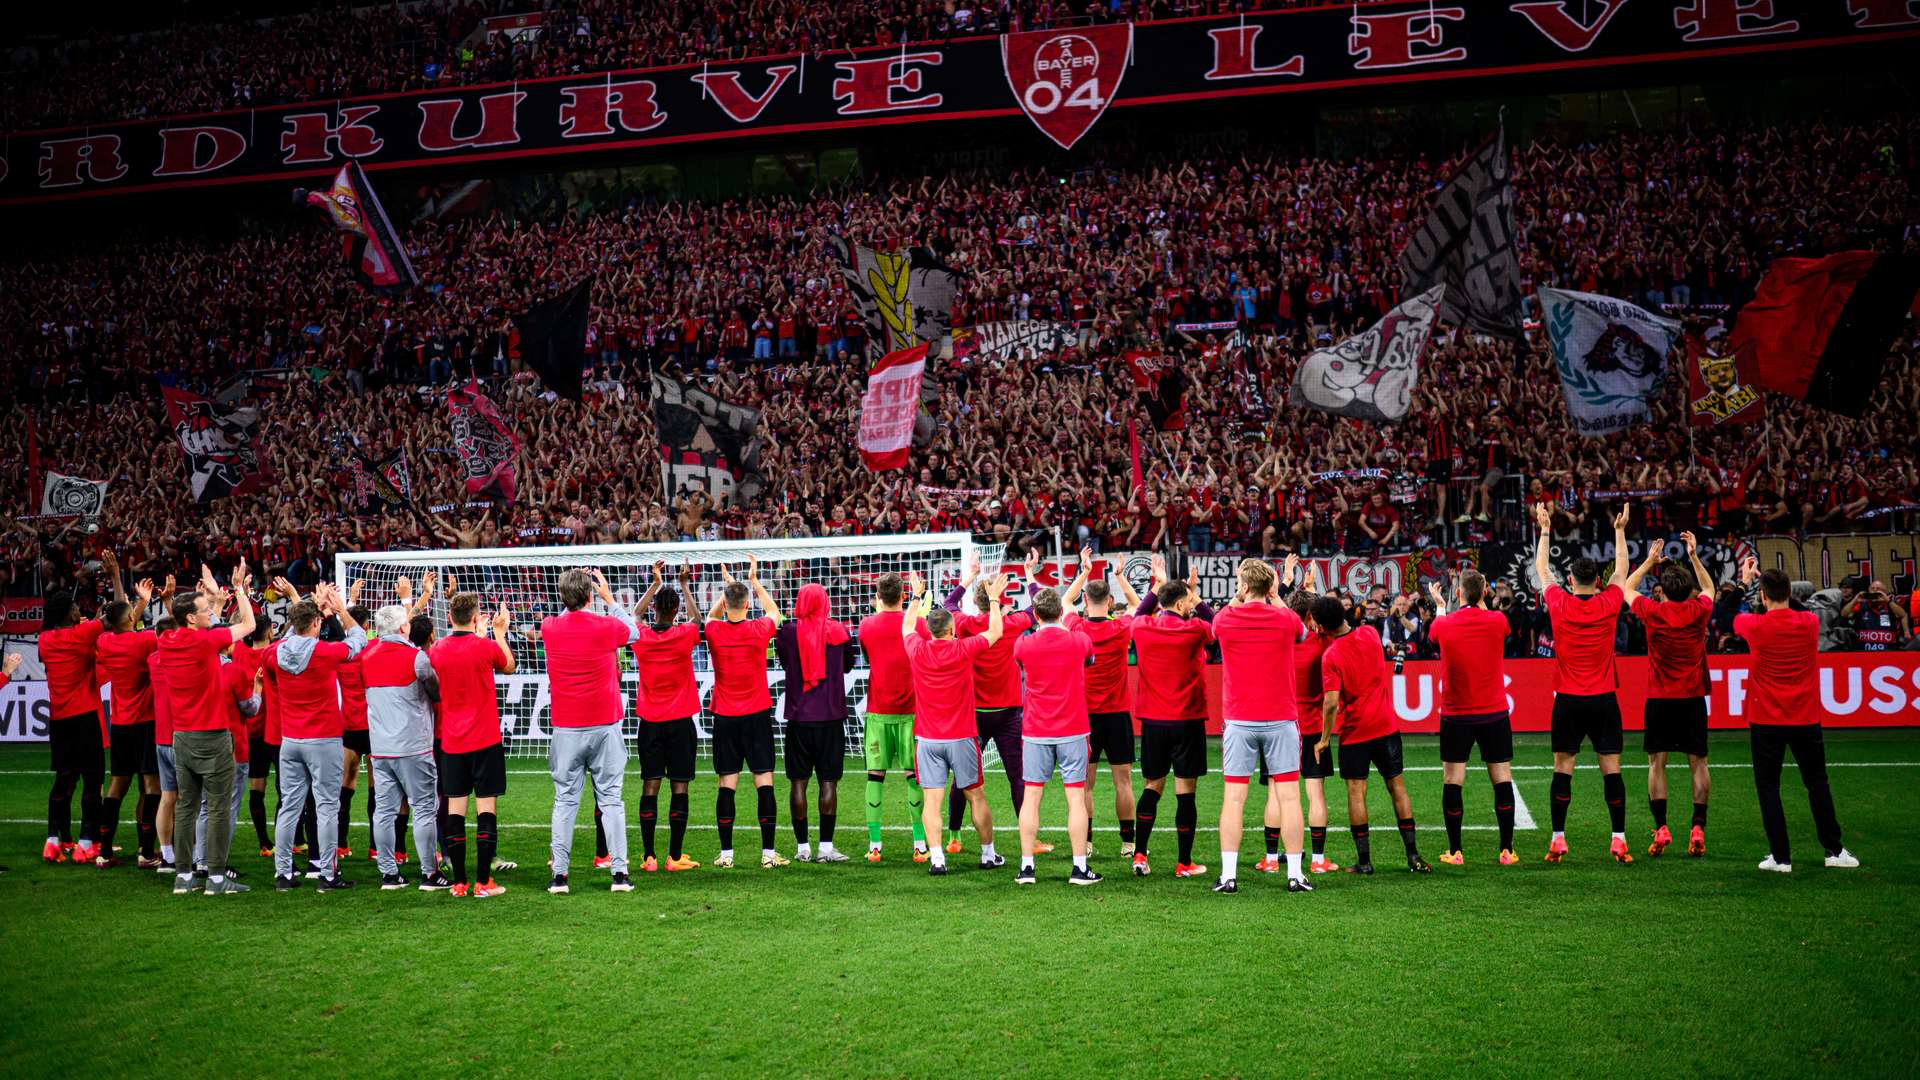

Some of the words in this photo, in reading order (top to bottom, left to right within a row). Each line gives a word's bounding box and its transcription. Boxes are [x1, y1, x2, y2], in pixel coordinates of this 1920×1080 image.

[1038, 55, 1095, 71] BAYER
[1024, 77, 1105, 115] 04
[0, 51, 943, 189] RDKURVE
[1706, 384, 1759, 421] XABI
[1187, 556, 1242, 577] WEST
[1858, 631, 1893, 641] PHOTO
